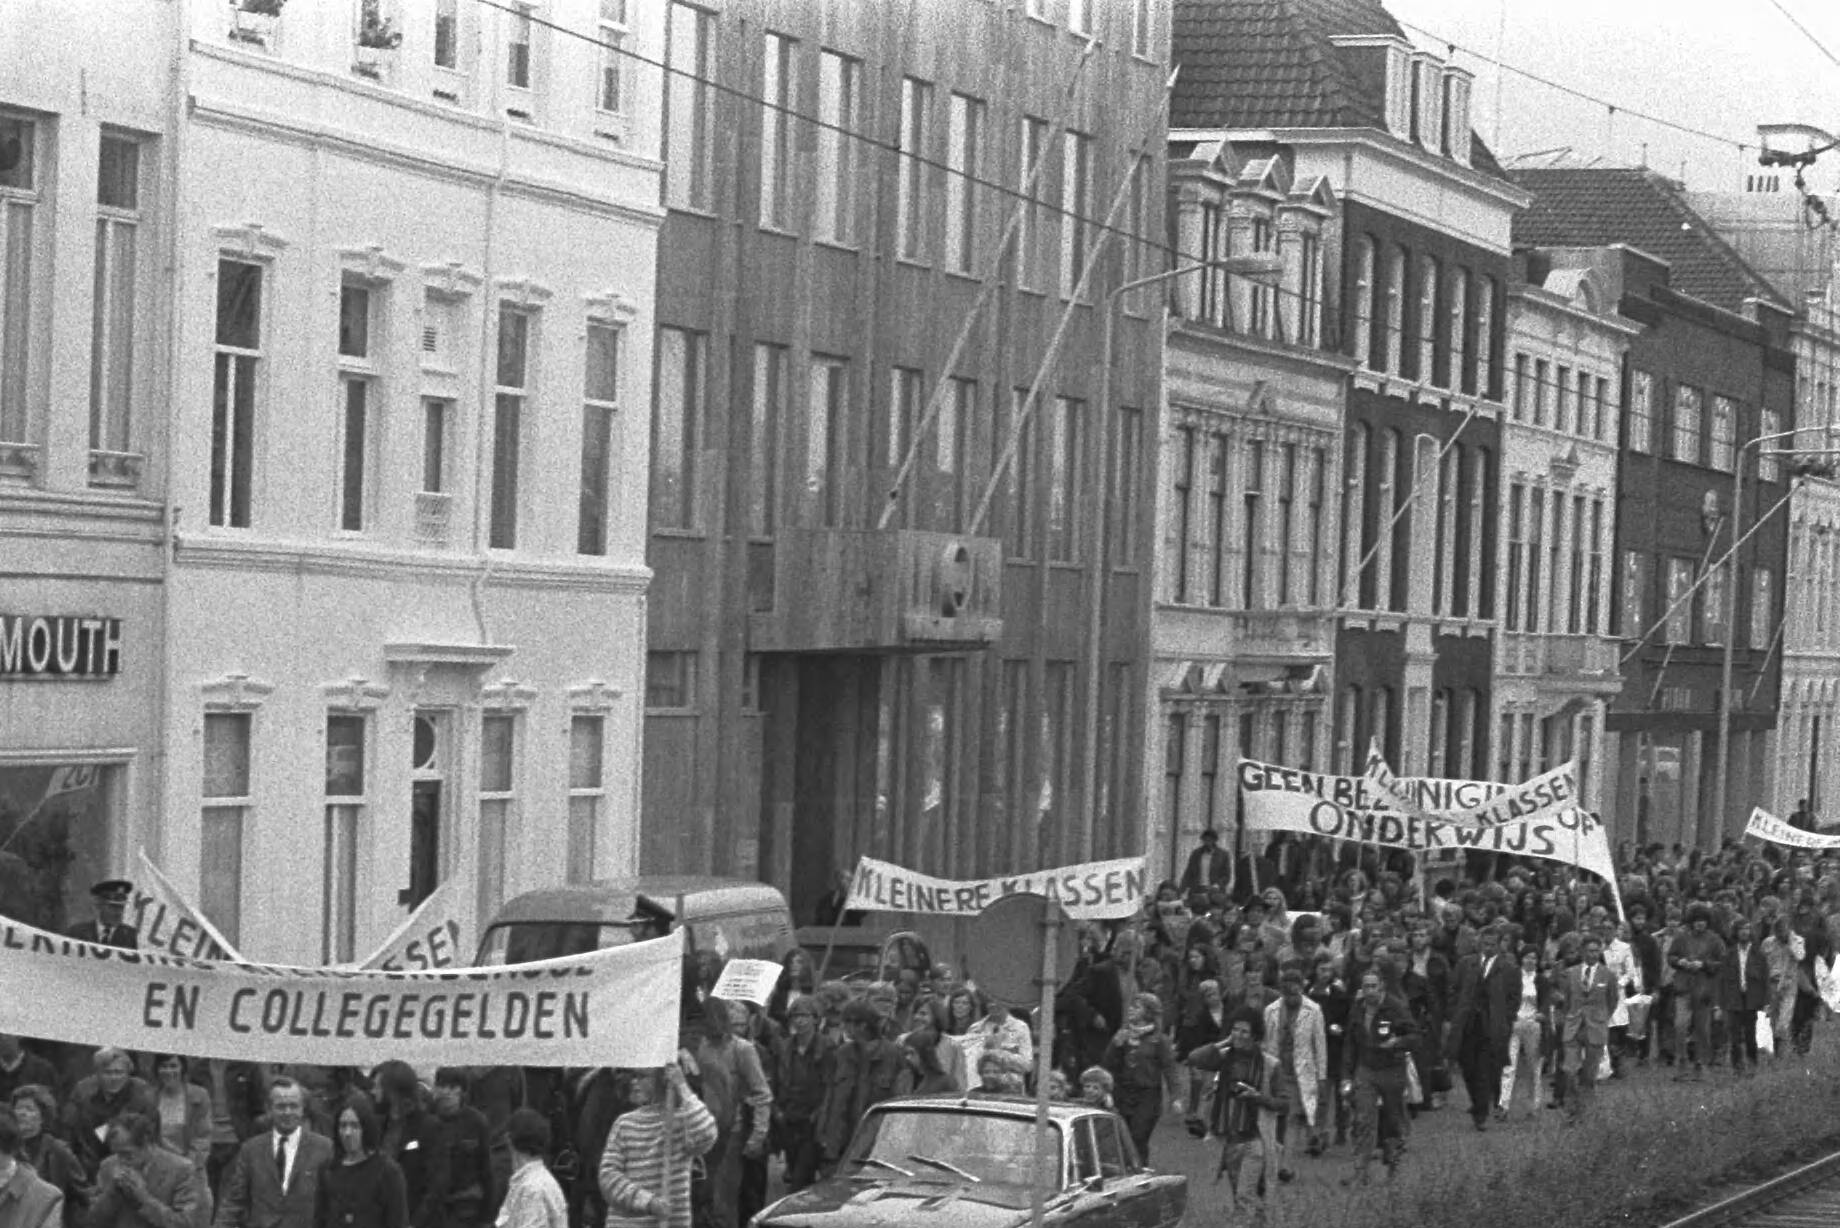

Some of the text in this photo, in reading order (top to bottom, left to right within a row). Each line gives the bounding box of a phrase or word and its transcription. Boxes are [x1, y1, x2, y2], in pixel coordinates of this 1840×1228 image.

[1238, 761, 1325, 800] GEEN
[1310, 800, 1556, 855] ONDERWIJS
[858, 864, 989, 912] KLEINERE
[143, 981, 590, 1039] EN COLLEGEGELDEN
